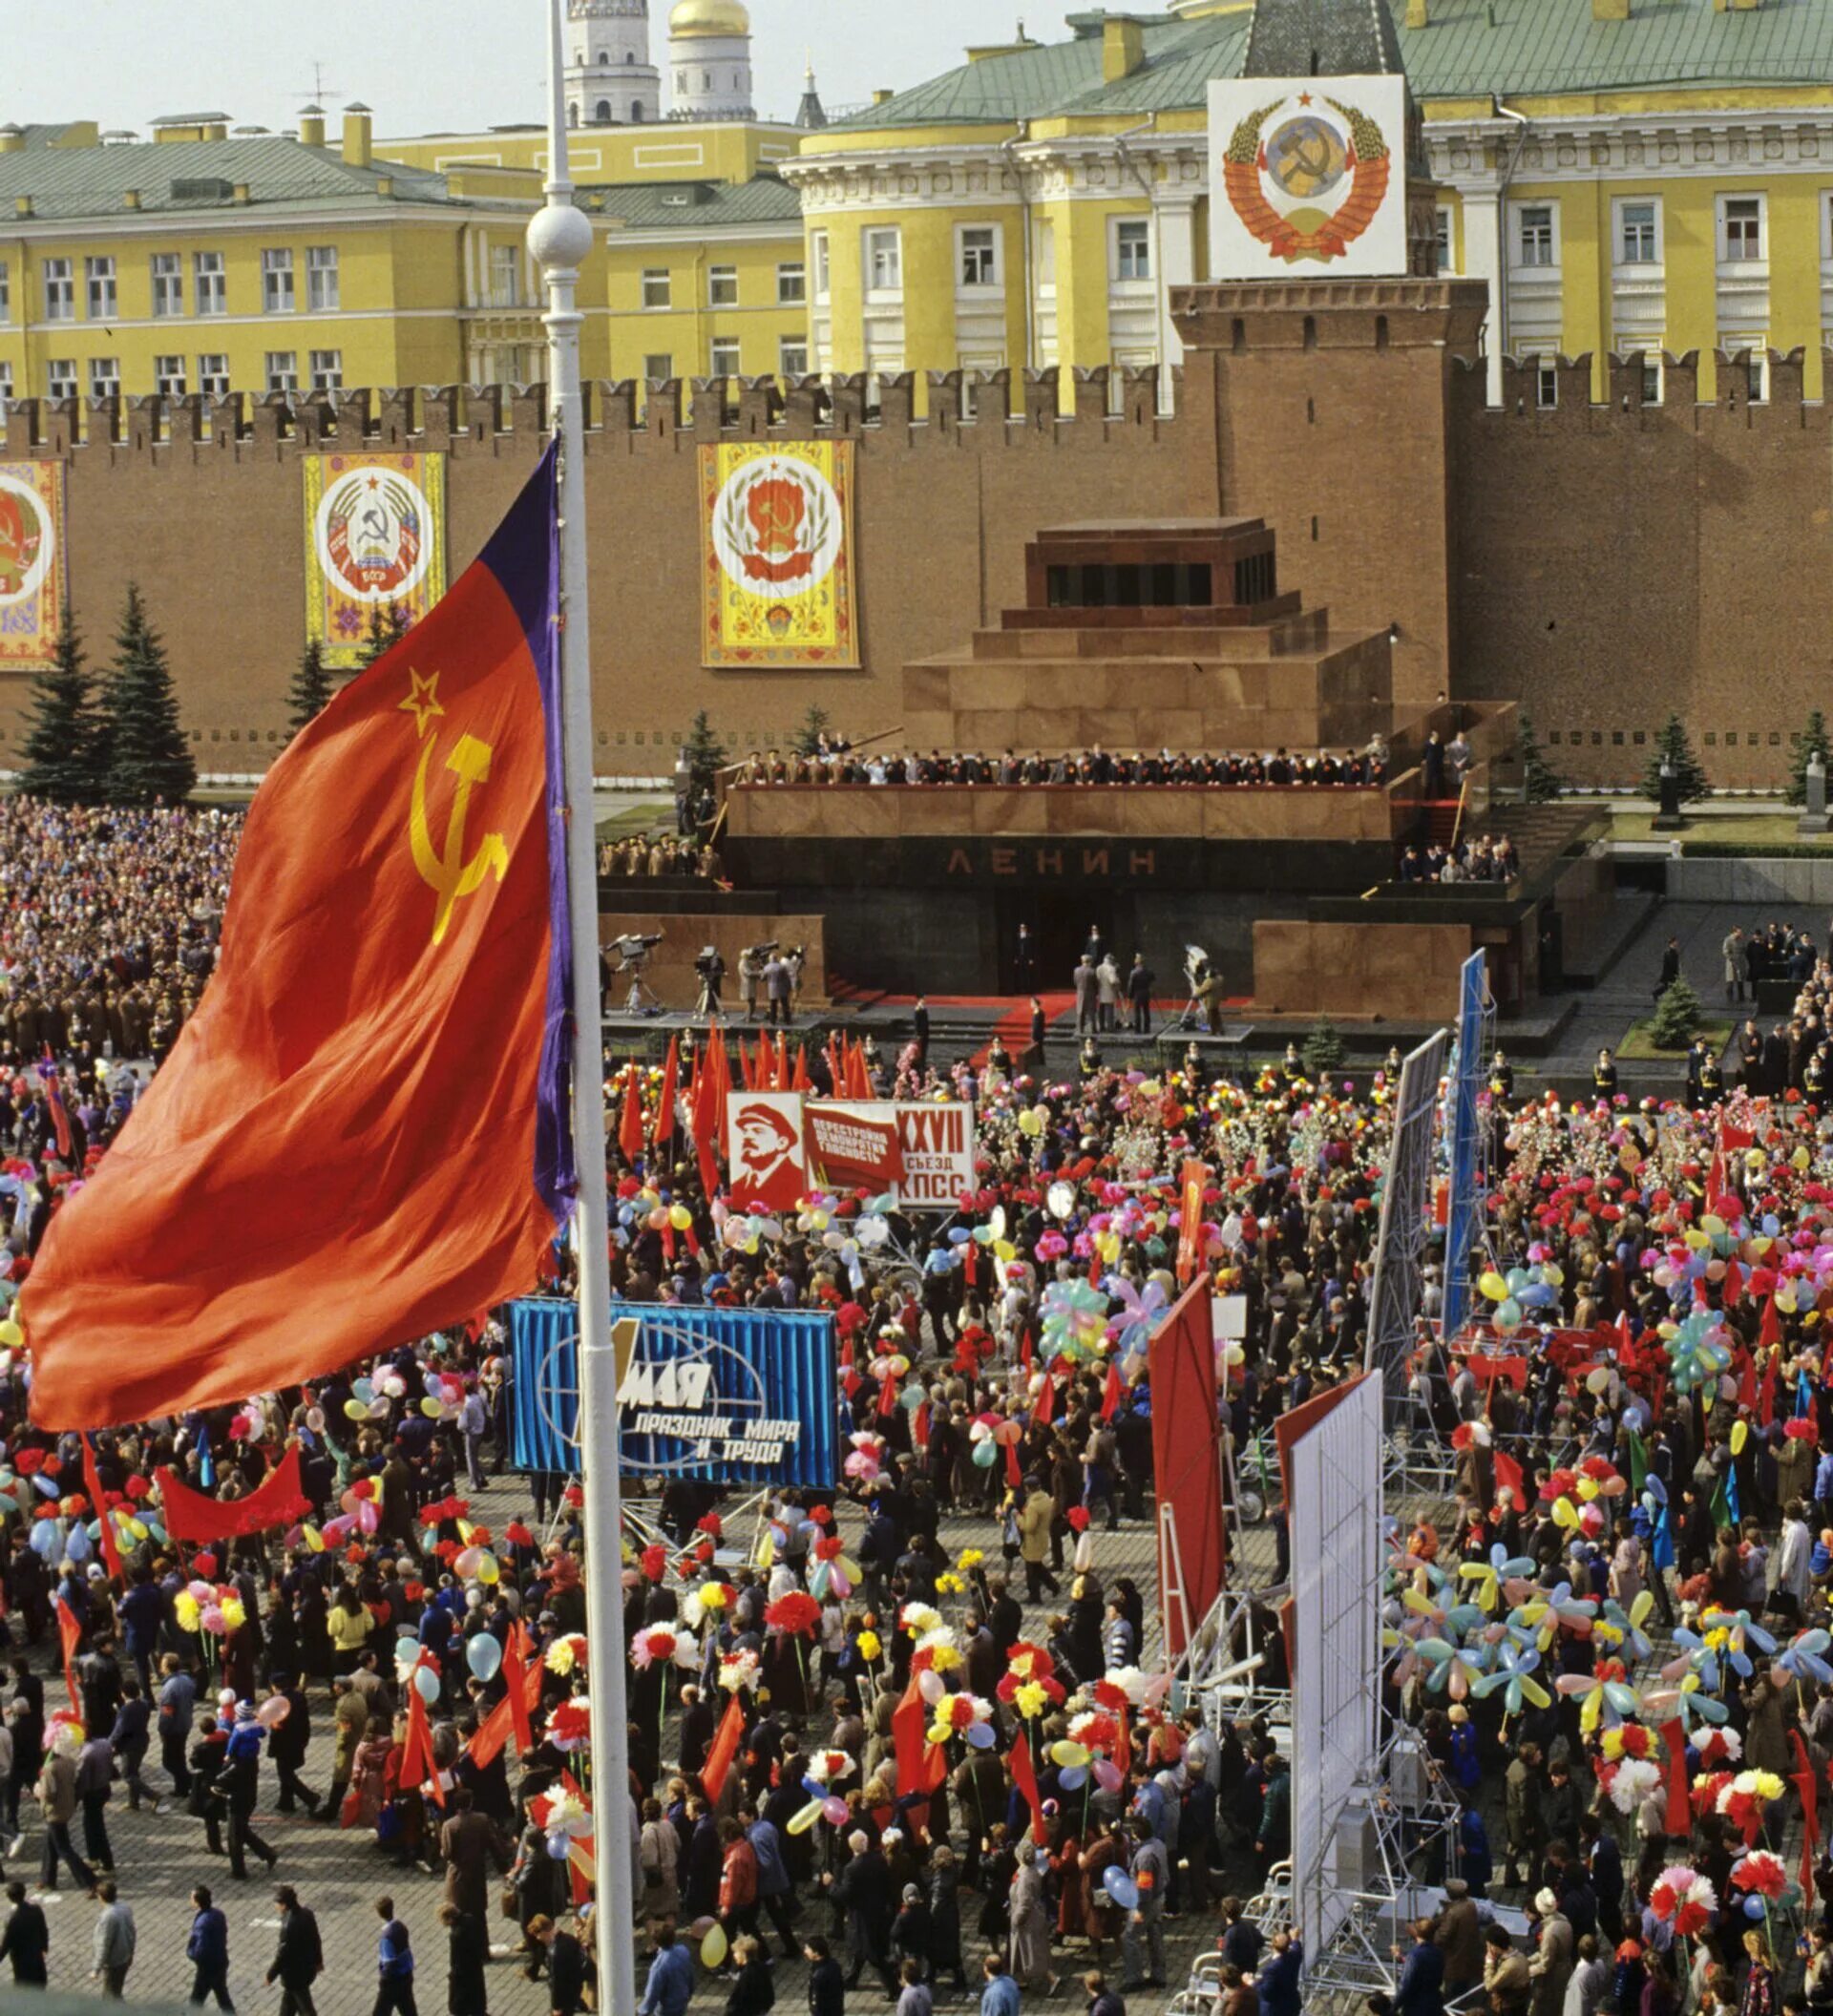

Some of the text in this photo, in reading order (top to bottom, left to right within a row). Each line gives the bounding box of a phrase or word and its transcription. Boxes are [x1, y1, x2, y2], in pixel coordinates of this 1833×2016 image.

[946, 849, 1155, 875] ЛЕНИН
[811, 1118, 889, 1145] ПЕРЕСТРОЙКА
[895, 1110, 963, 1153] XXVII
[819, 1141, 881, 1165] ГЛАСНОСТЬ
[906, 1157, 954, 1171] СЪЕЗД
[897, 1173, 965, 1199] КПСС
[615, 1355, 712, 1411] МАЯ
[635, 1413, 801, 1442] ПРАЗДНИК МИРА
[697, 1438, 783, 1463] И ТРУДА
